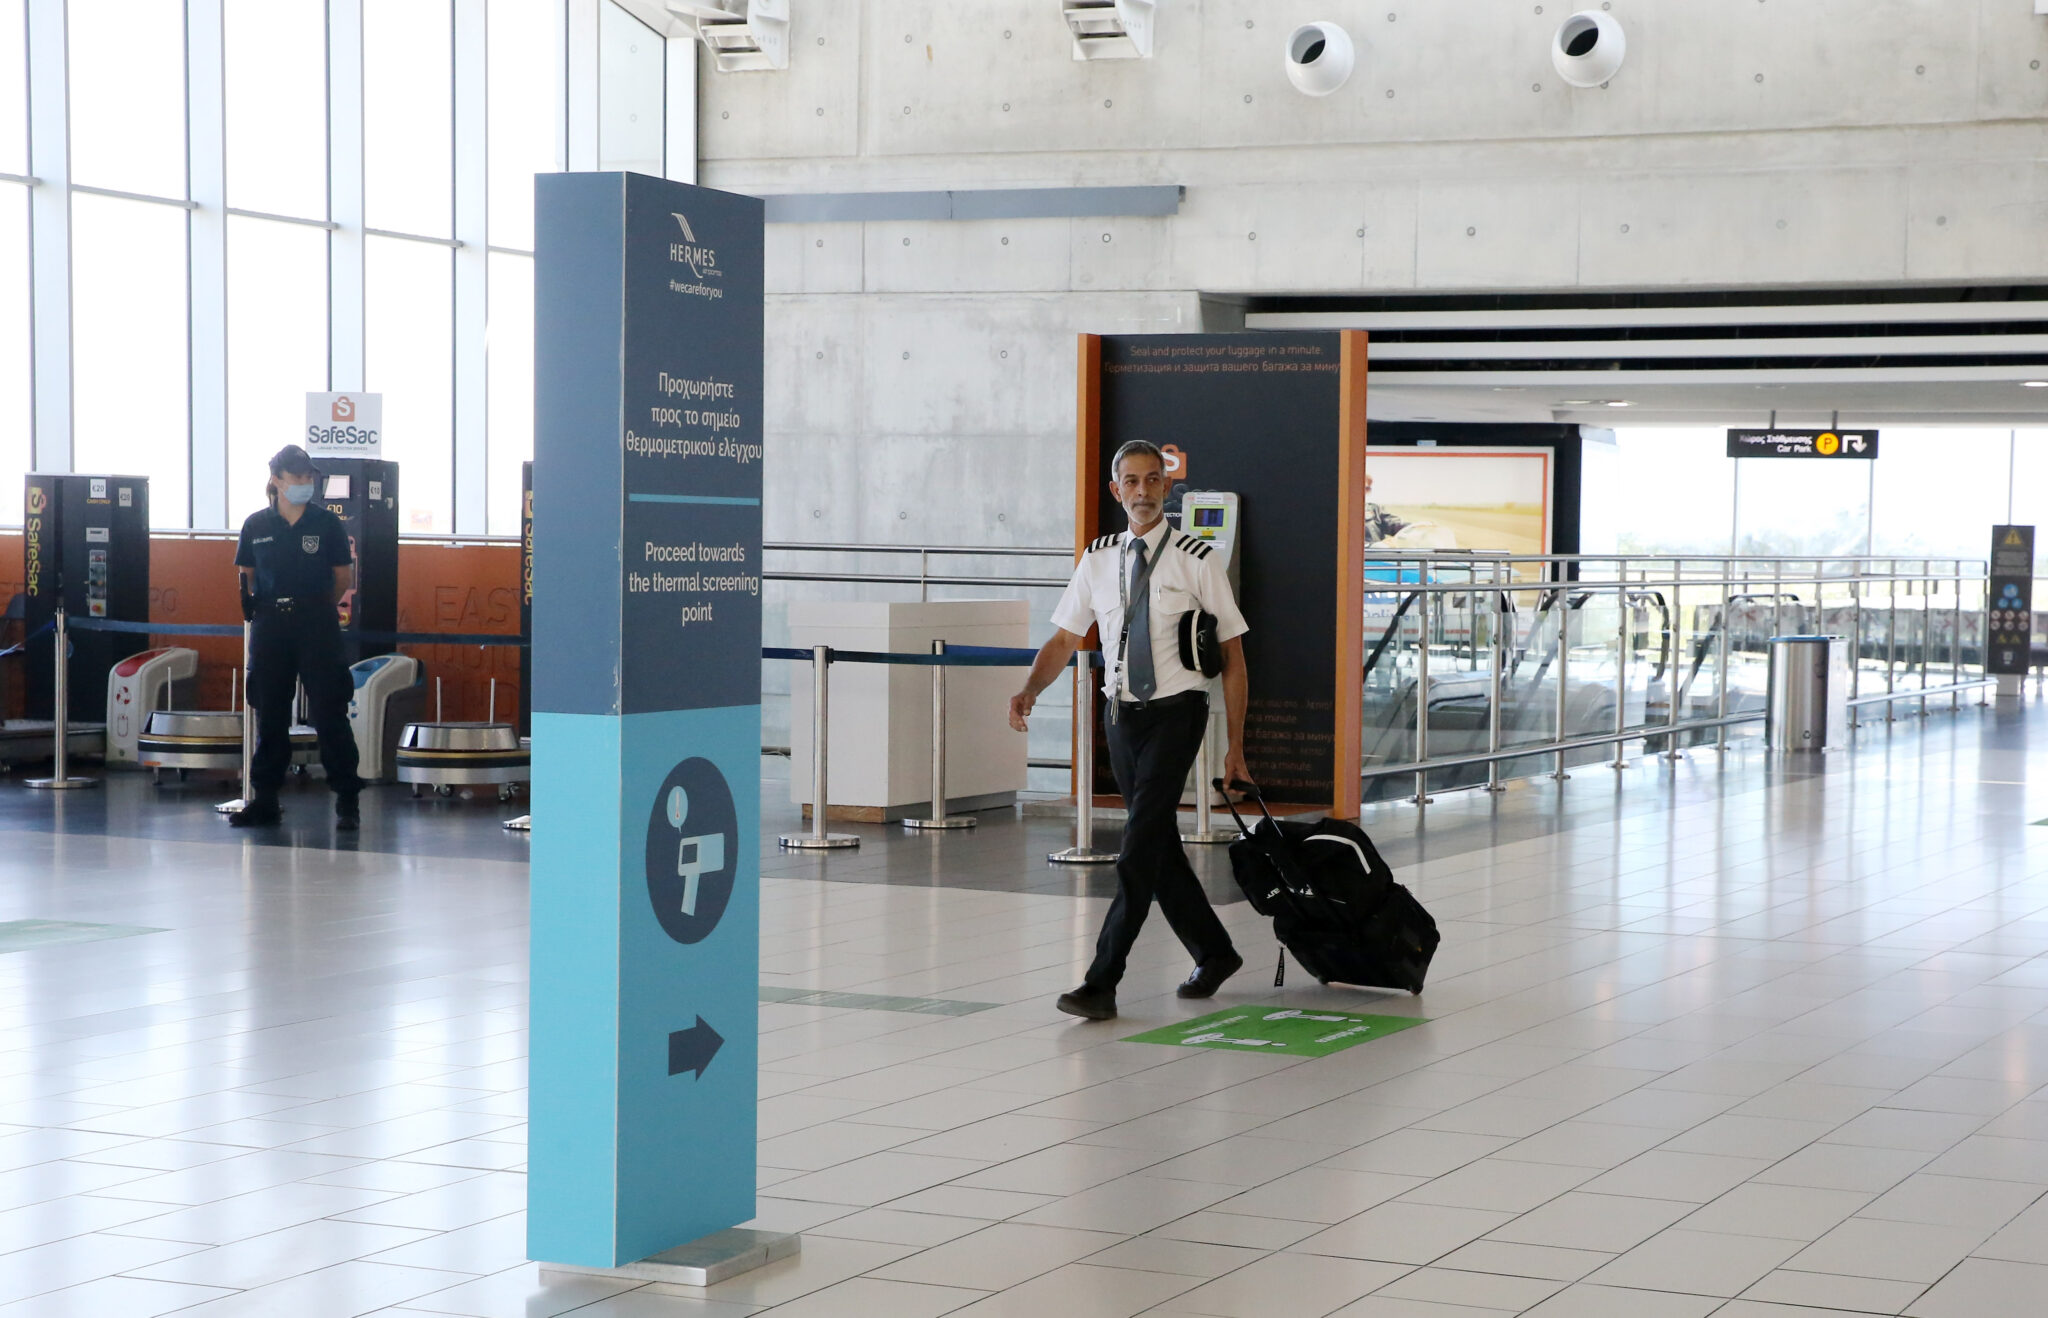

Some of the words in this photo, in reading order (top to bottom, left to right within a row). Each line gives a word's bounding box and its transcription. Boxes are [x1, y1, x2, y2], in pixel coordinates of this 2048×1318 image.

[670, 243, 715, 276] HERMES
[669, 279, 723, 301] #wecareforyou
[1131, 346, 1149, 357] Seal
[1152, 346, 1169, 357] and
[1171, 345, 1203, 358] protect
[1206, 348, 1226, 358] your
[1228, 345, 1265, 358] luggage
[1268, 345, 1277, 355] in
[1174, 364, 1181, 372] и
[1184, 364, 1219, 374] защита
[1222, 363, 1258, 373] вашего
[1262, 361, 1298, 372] багажа
[1301, 364, 1312, 372] за
[1314, 364, 1340, 375] мину
[659, 372, 734, 401] Προχωρήστε
[651, 407, 681, 428] προς
[684, 410, 699, 425] το
[702, 408, 740, 431] σημείο
[308, 425, 378, 444] SafeSac
[1824, 437, 1833, 449] P
[626, 430, 716, 459] θερμομετρικού
[718, 437, 762, 464] ελέγχου
[27, 518, 41, 597] SafeSac
[645, 541, 696, 562] Proceed
[698, 542, 745, 562] towards
[629, 572, 650, 593] the
[653, 572, 701, 593] thermal
[702, 571, 759, 596] screening
[435, 586, 520, 628] EAS
[682, 602, 713, 627] point
